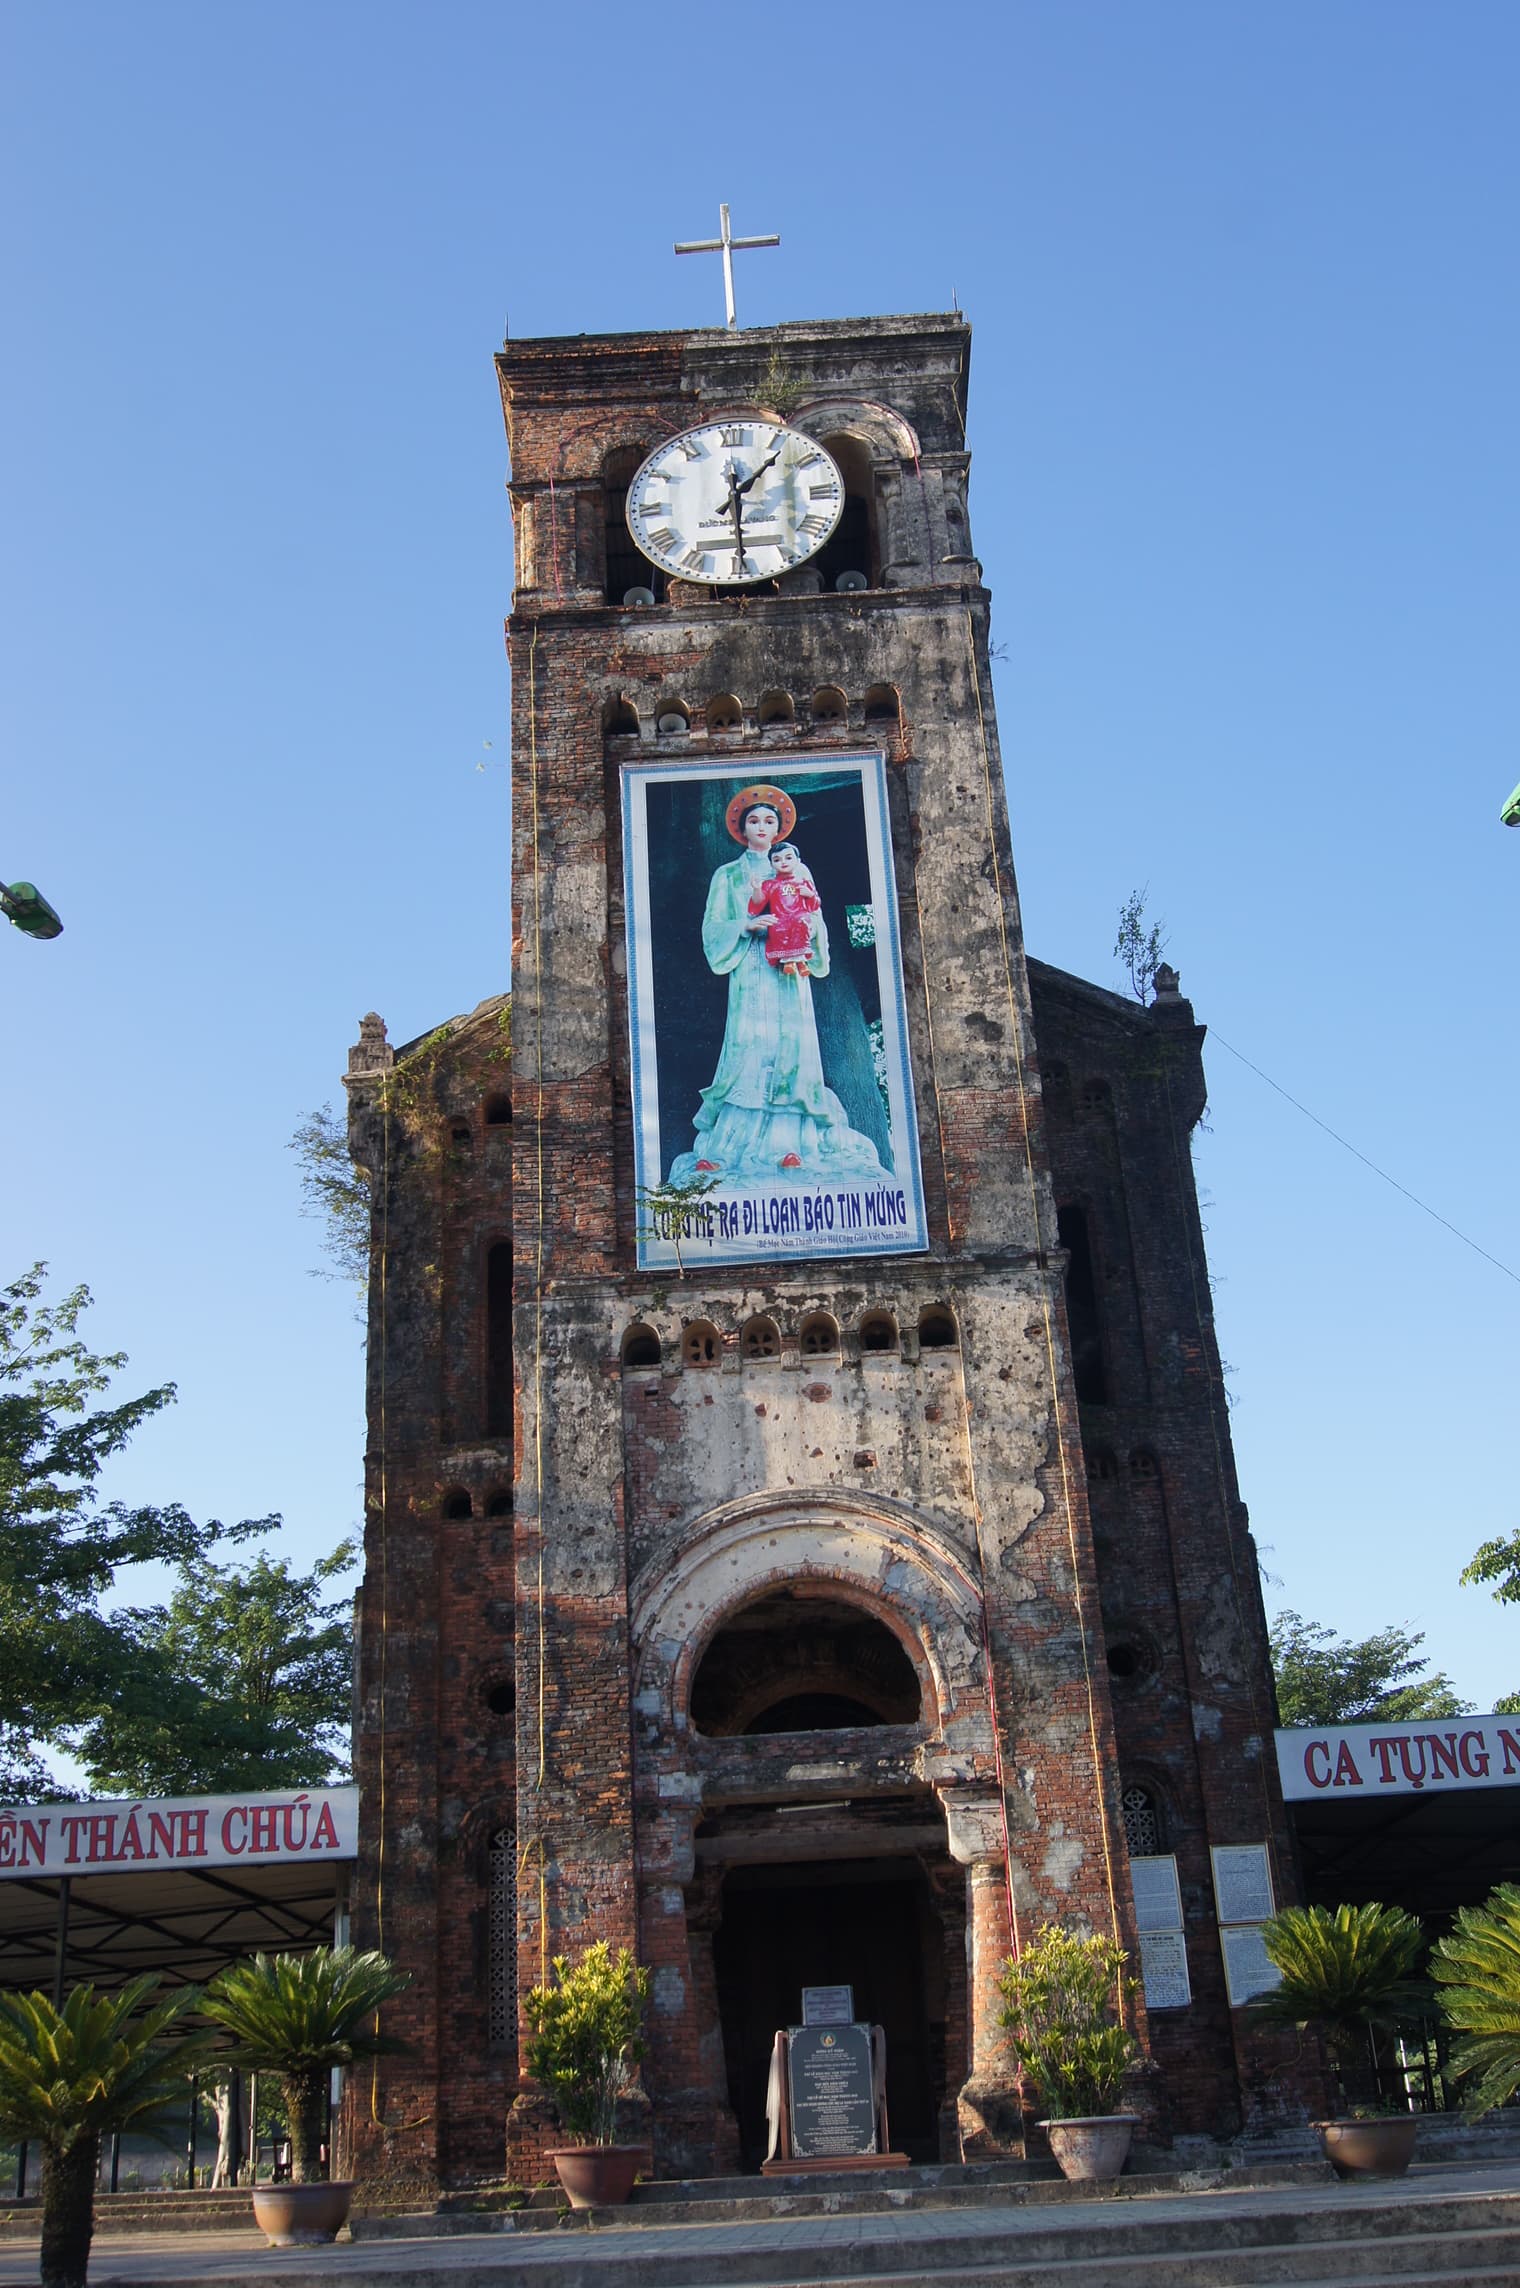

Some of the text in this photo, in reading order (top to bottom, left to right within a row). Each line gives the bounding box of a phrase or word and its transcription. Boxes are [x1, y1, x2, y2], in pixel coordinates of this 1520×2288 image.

[676, 439, 701, 461] XI
[719, 428, 744, 447] XII
[808, 483, 832, 500] III
[720, 1200, 739, 1240] RA
[743, 1199, 758, 1235] ĐI
[762, 1196, 800, 1236] LOAN
[803, 1186, 834, 1234] BÁO
[837, 1192, 862, 1229] TIN
[865, 1182, 906, 1228] MỪNG
[1304, 1739, 1363, 1788] CA
[1370, 1731, 1490, 1788] TỤNG
[61, 1804, 209, 1864] THÁNH
[221, 1794, 339, 1855] CHÚA
